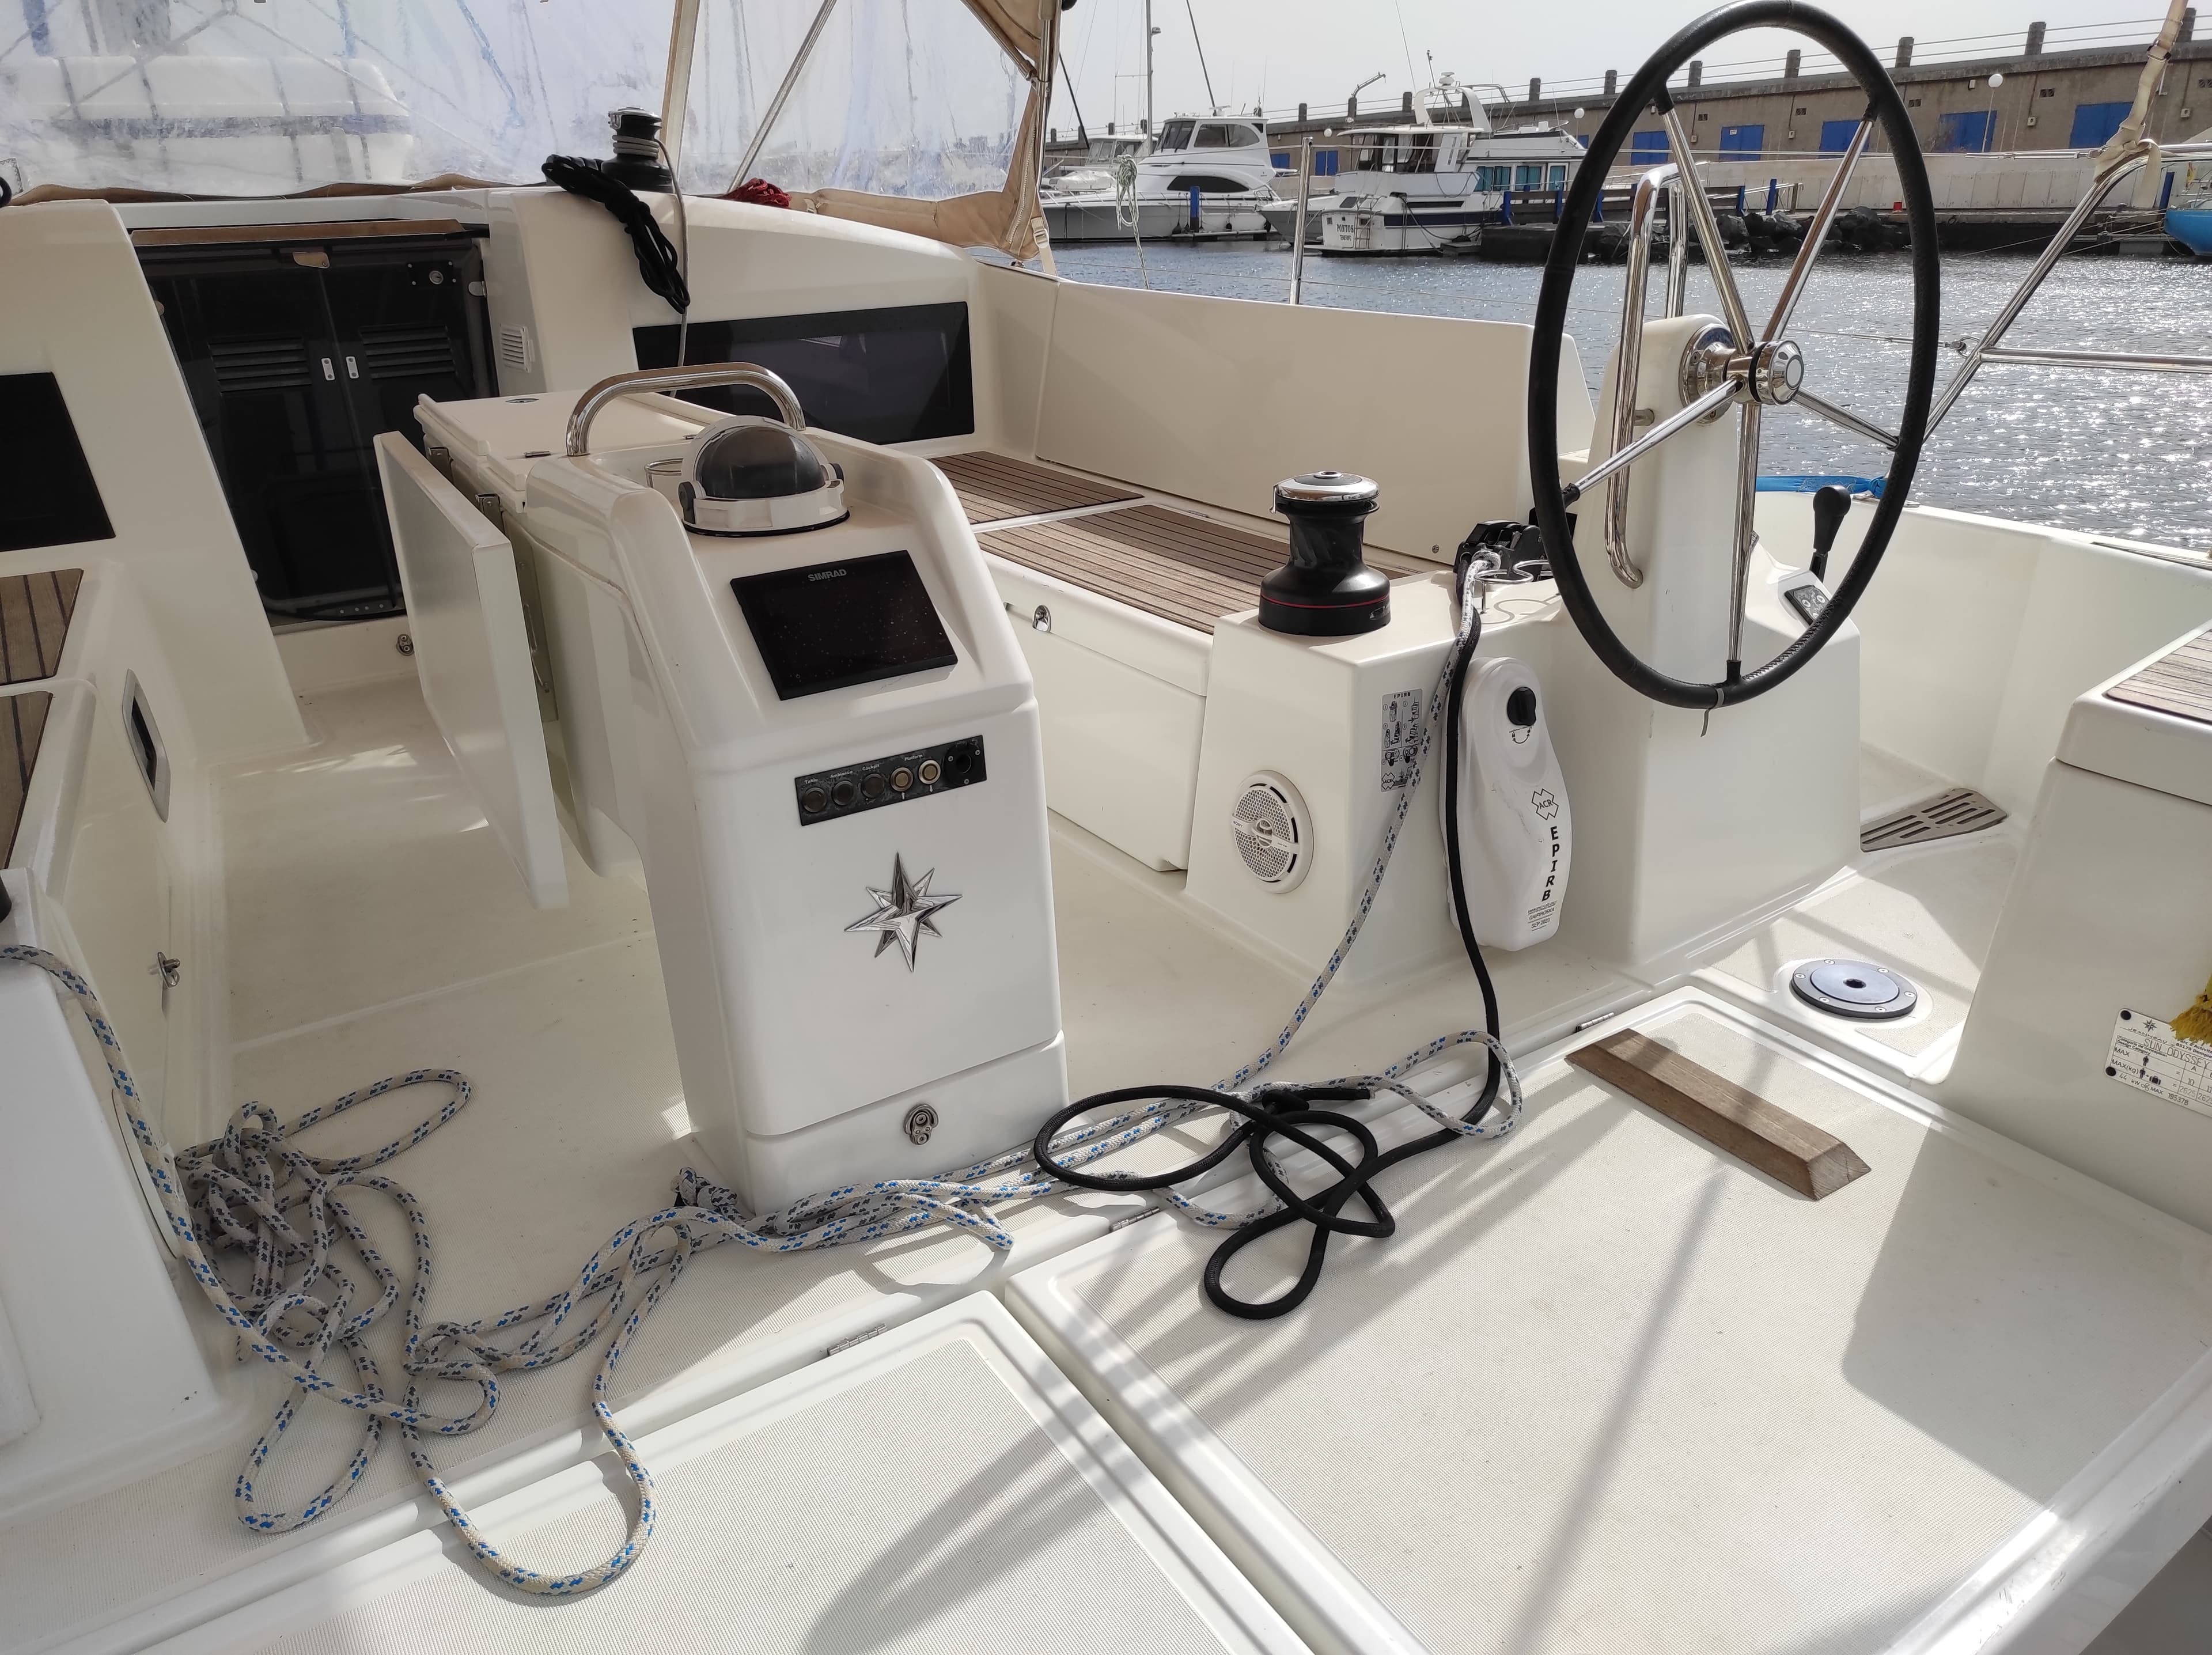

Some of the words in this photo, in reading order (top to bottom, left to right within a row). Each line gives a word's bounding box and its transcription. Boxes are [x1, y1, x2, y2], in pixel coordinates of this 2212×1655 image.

[1336, 224, 1354, 233] PONTOS
[808, 569, 847, 581] SIMRAD
[1539, 799, 1554, 809] ACR
[1541, 825, 1560, 902] EPIRB
[2128, 1027, 2168, 1043] JEANNEAU
[2114, 1047, 2130, 1057] MAX
[2143, 1038, 2162, 1051] SUN
[2166, 1047, 2210, 1069] ODYSSEY
[2188, 1078, 2195, 1086] 10
[2150, 1086, 2164, 1095] MAX
[2168, 1092, 2189, 1105] 195378
